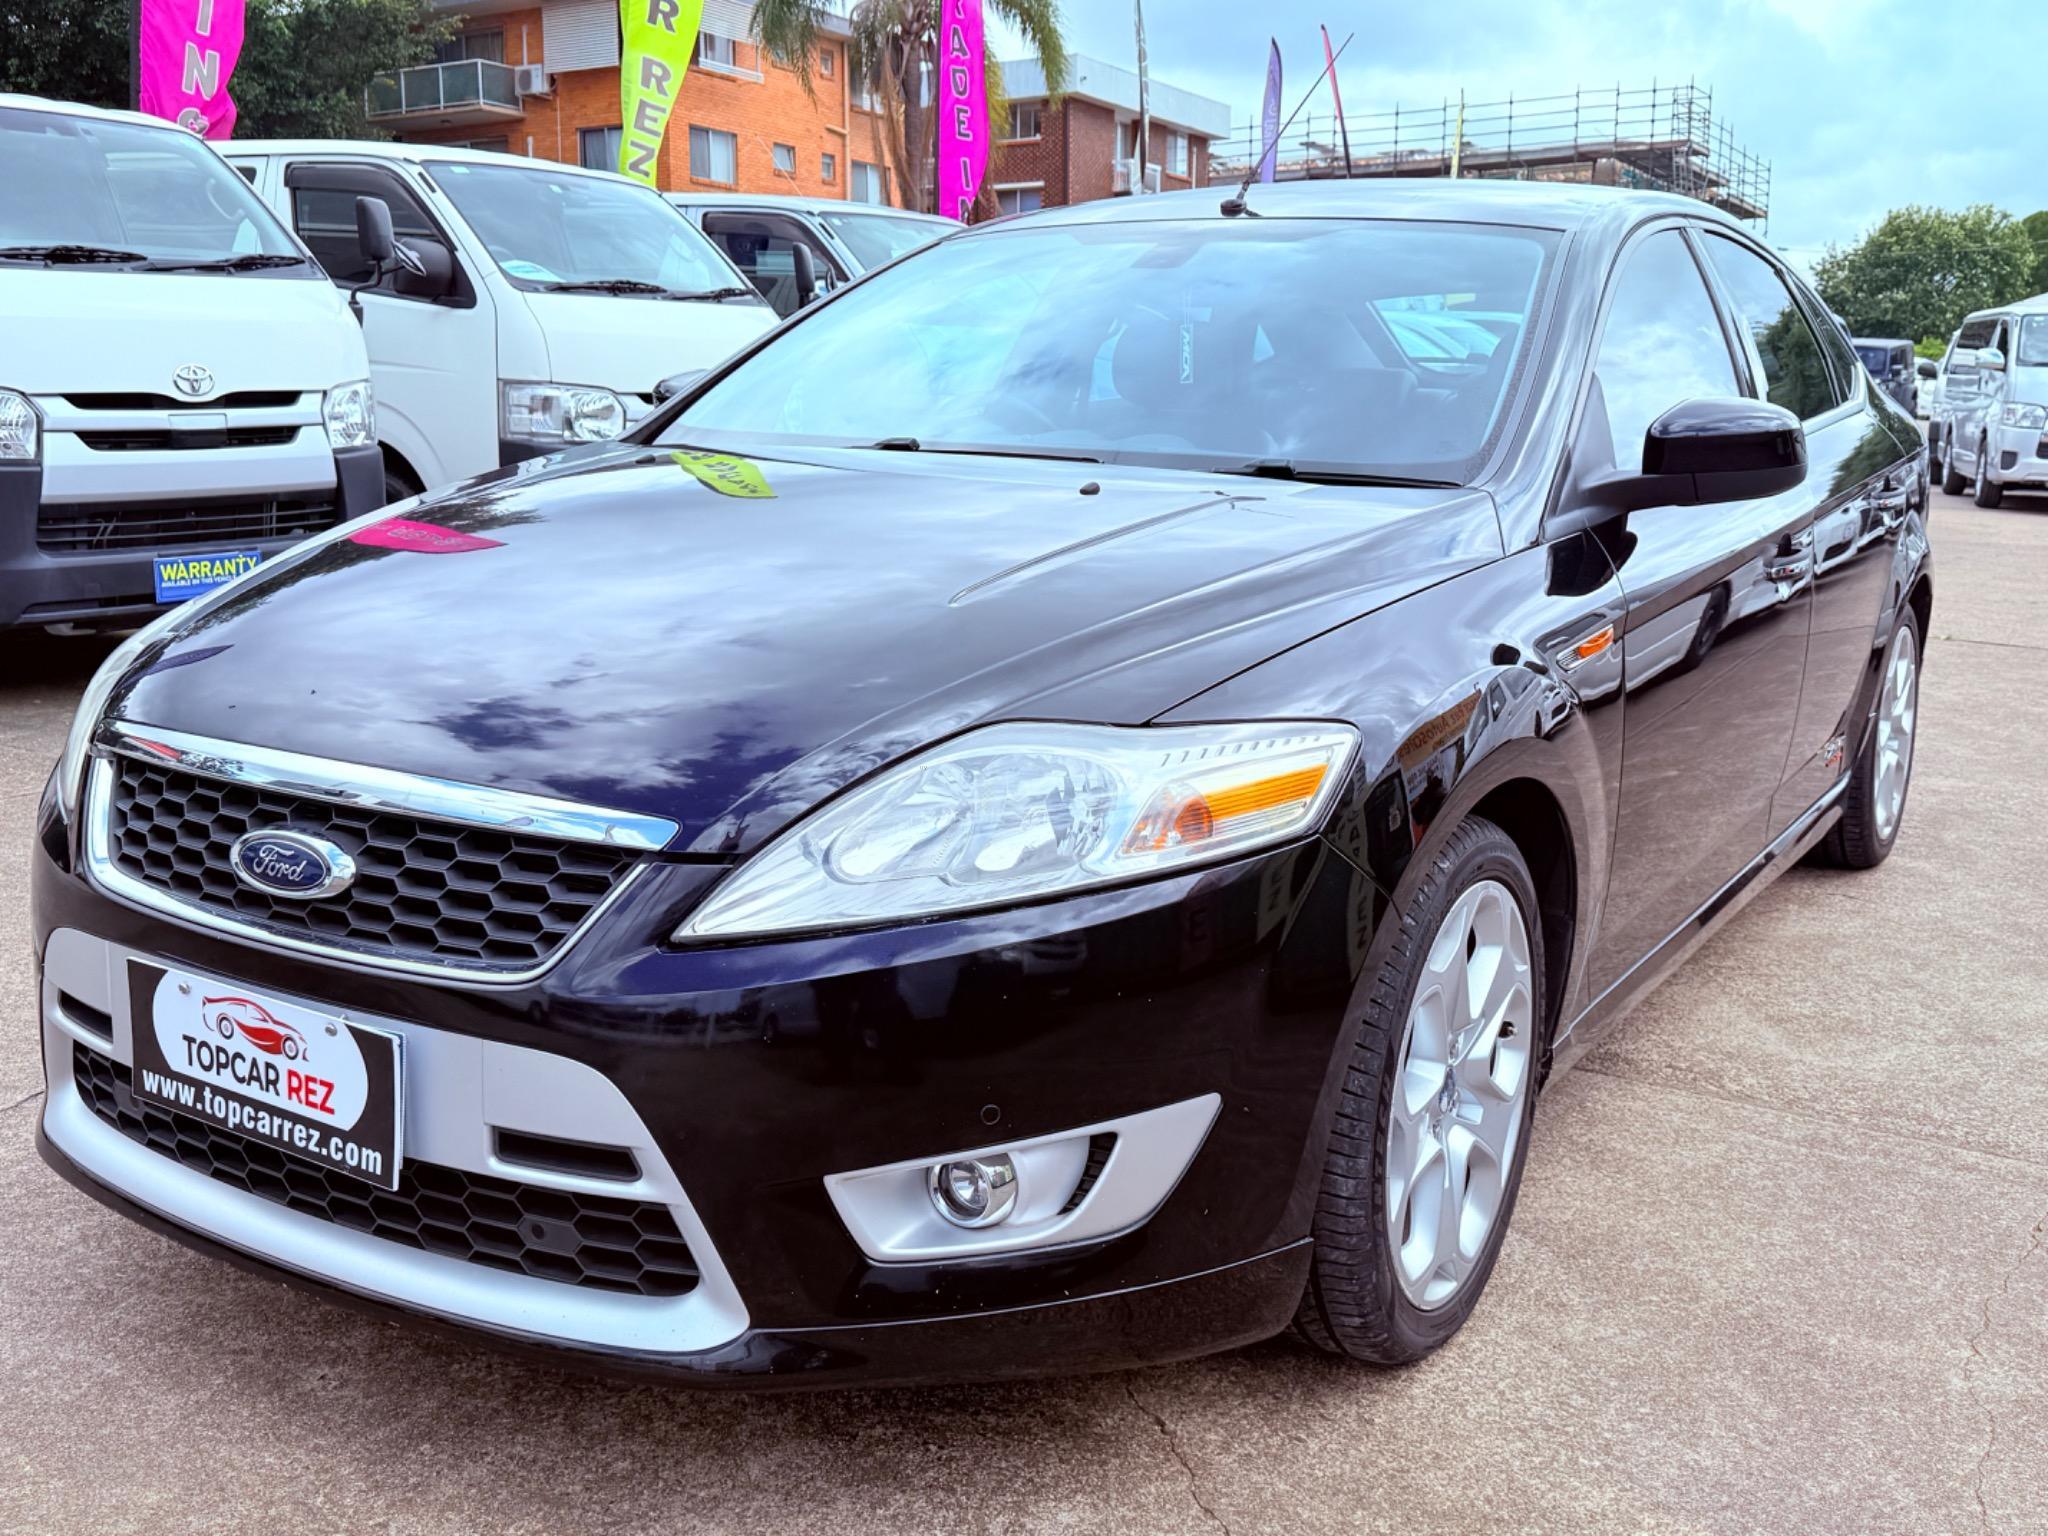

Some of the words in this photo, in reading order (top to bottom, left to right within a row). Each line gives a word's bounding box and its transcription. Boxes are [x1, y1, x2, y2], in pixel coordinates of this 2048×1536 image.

[628, 55, 672, 179] REZ
[160, 556, 257, 581] WARRANTY
[253, 844, 307, 881] Ford
[182, 1034, 280, 1096] TOPCAR
[287, 1069, 335, 1115] REZ
[142, 1068, 382, 1176] www.topcarrez.com
